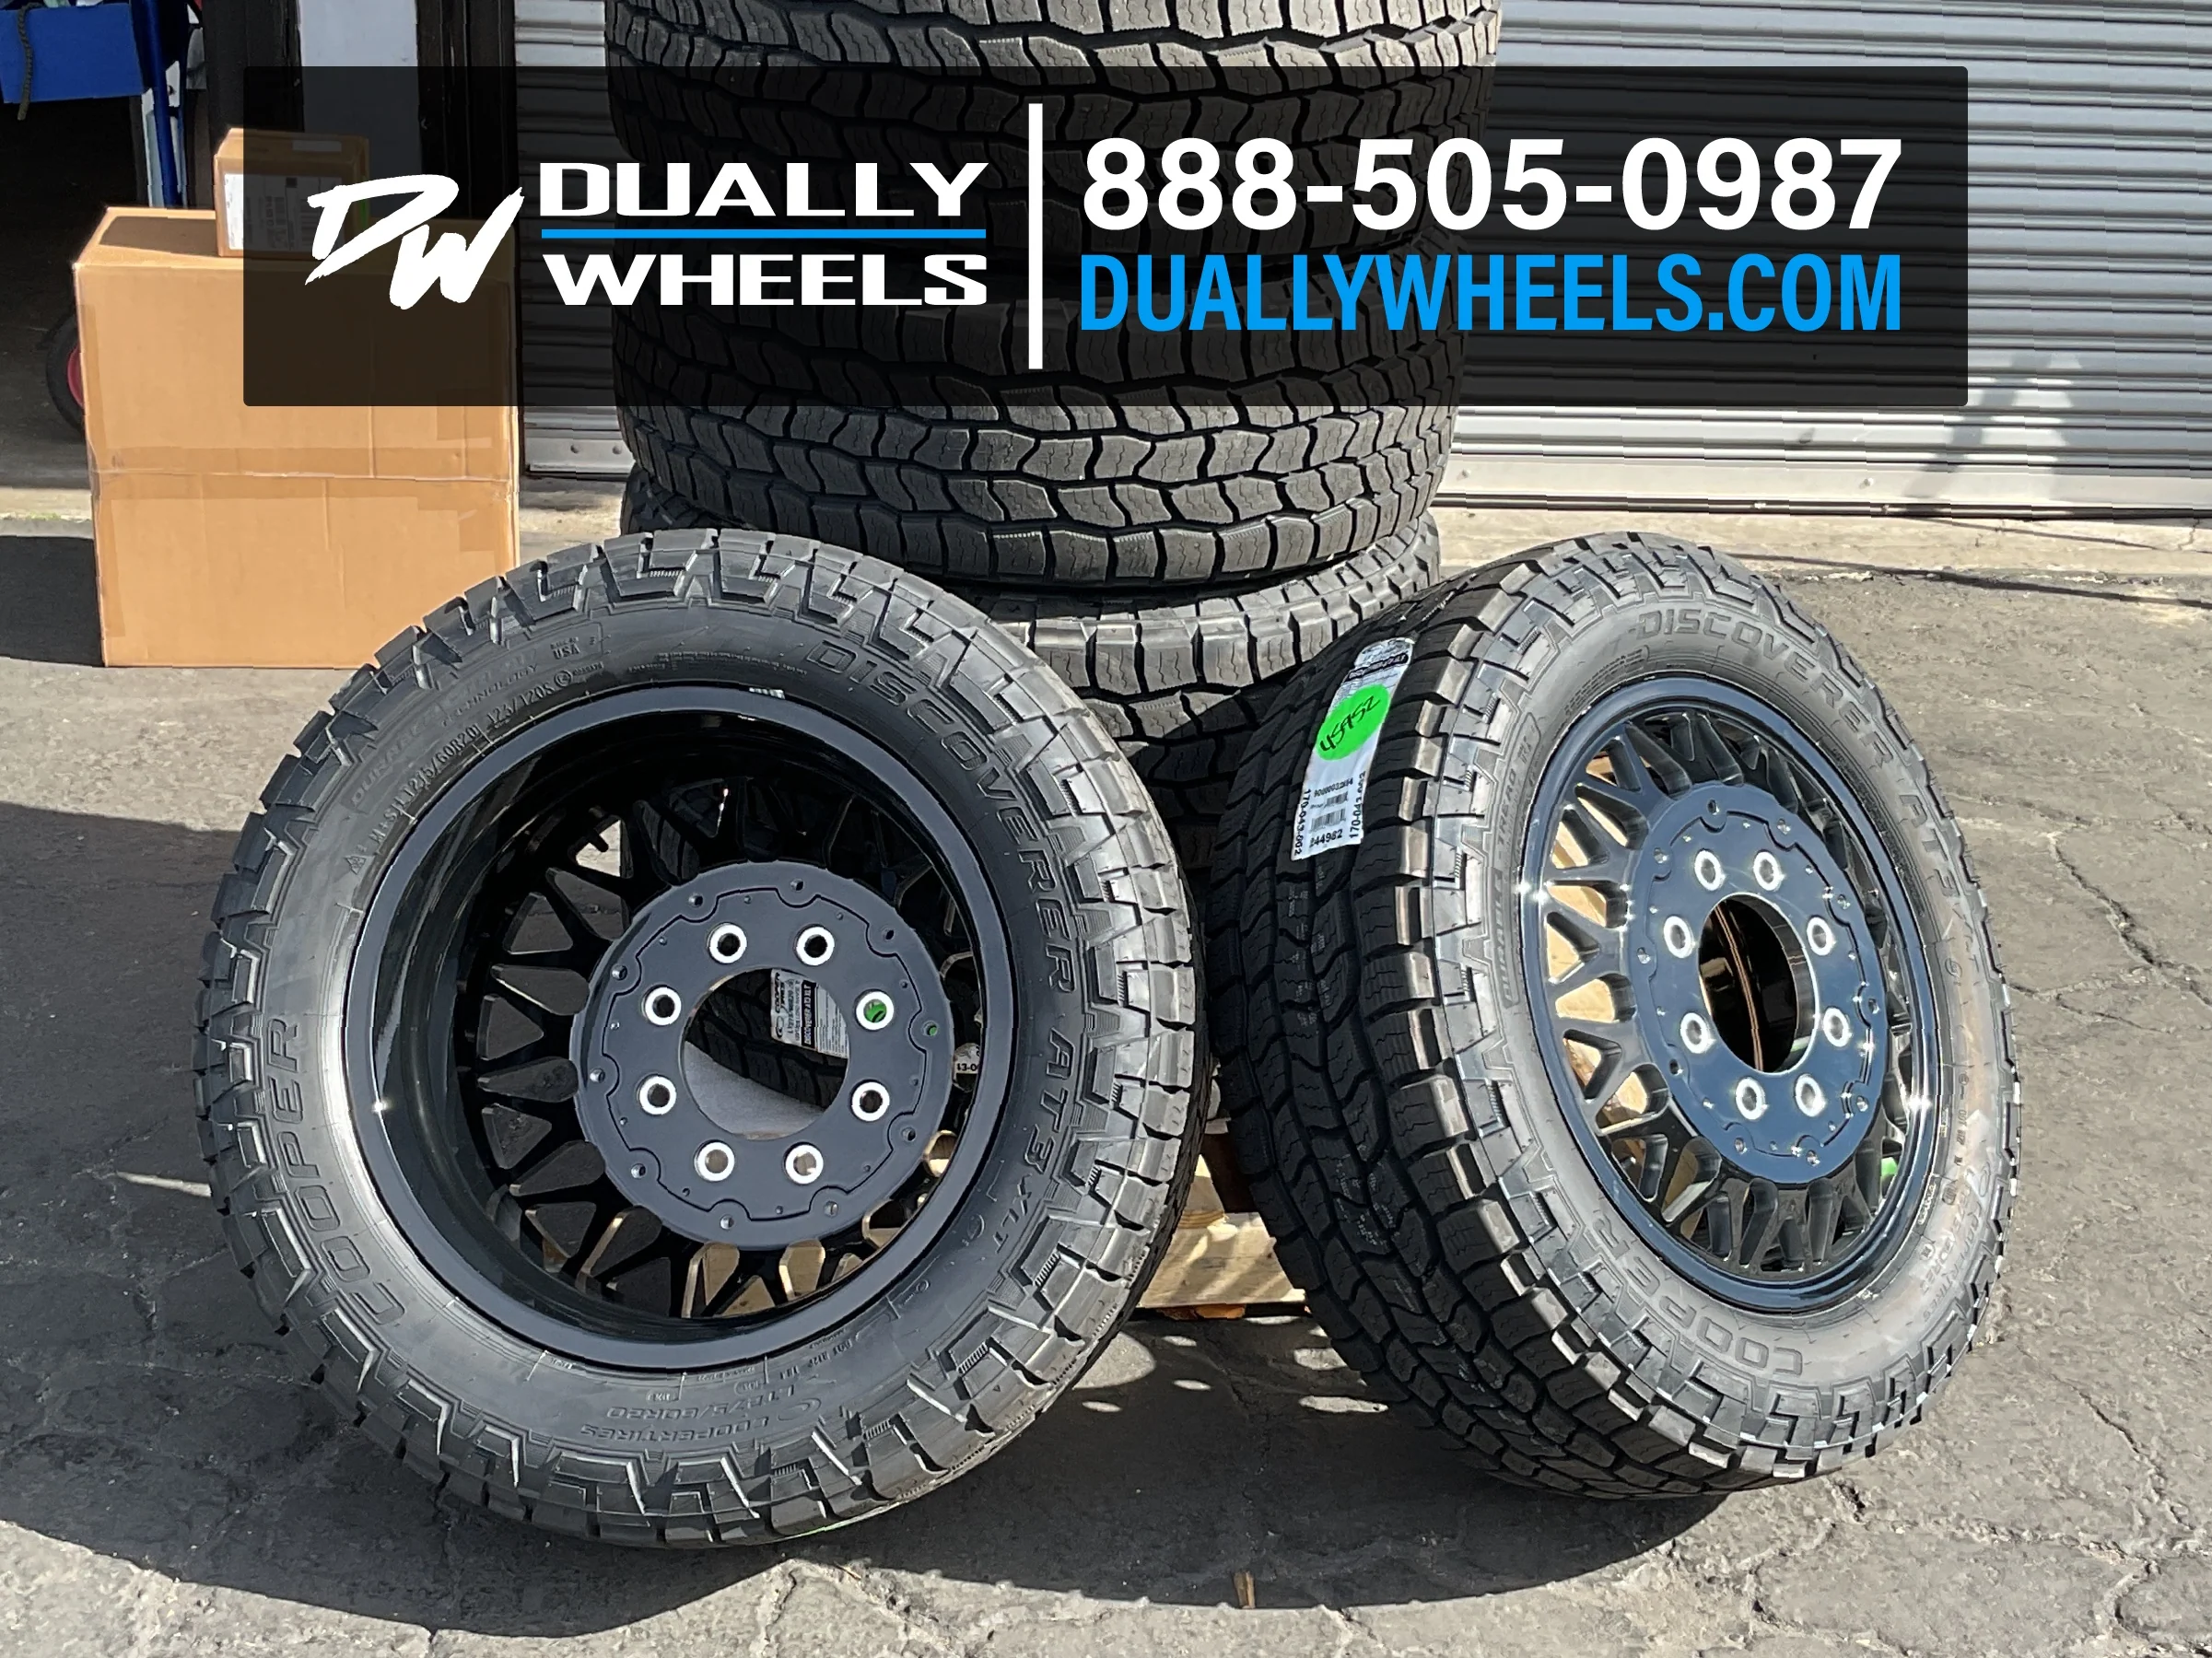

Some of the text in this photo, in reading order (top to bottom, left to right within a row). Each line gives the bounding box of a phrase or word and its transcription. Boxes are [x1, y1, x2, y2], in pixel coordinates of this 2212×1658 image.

[1636, 608, 1894, 769] DISCOVERER
[806, 639, 1077, 994] DISCOVERER
[1024, 1026, 1076, 1174] AT3
[267, 1018, 406, 1325] COOPER
[1593, 1214, 1803, 1376] COOPER
